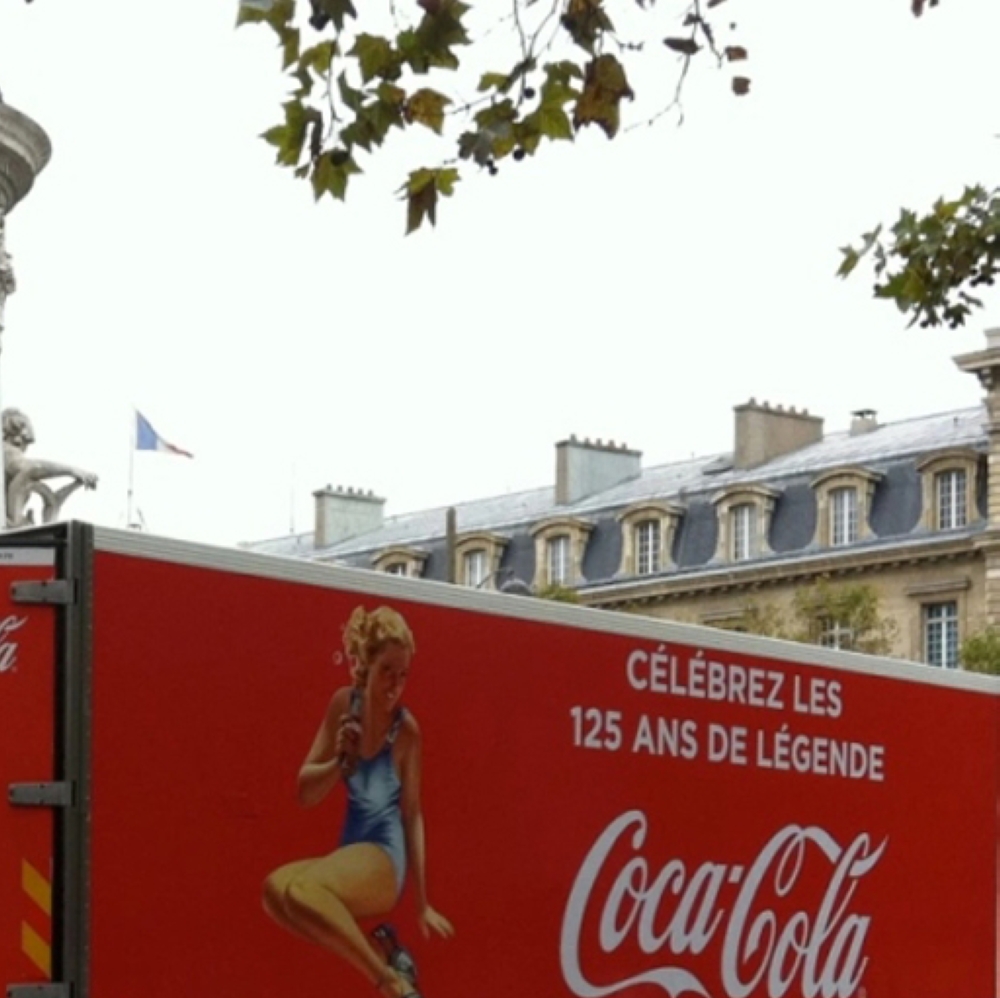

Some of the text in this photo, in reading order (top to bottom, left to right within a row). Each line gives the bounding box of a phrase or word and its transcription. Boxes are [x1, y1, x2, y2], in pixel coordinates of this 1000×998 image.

[627, 645, 843, 718] CÉLÉBREZ LES
[570, 706, 886, 781] 125 ANS DE LÉGENDE
